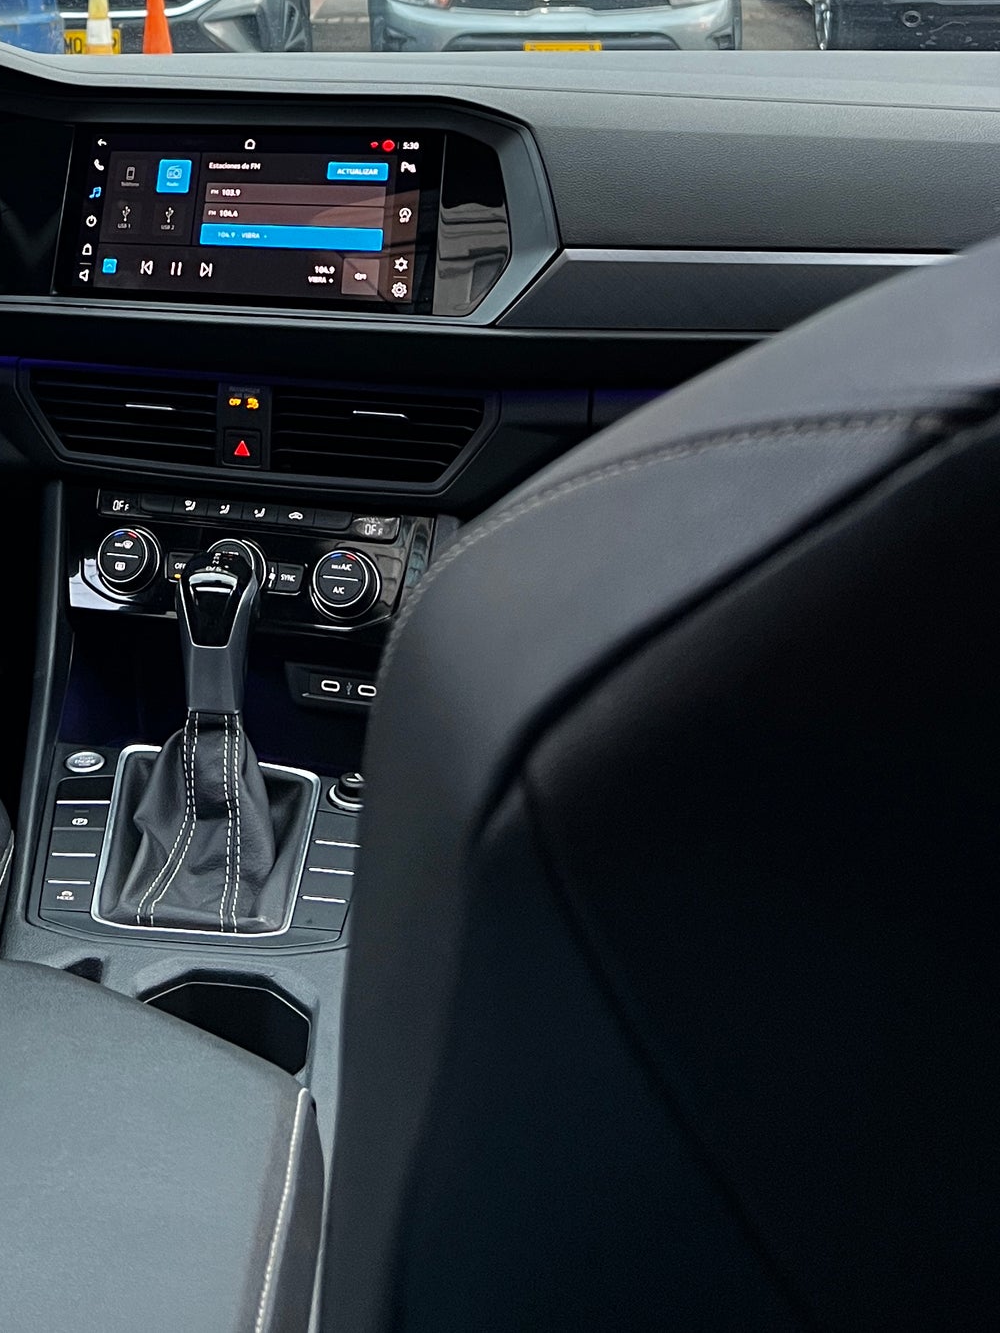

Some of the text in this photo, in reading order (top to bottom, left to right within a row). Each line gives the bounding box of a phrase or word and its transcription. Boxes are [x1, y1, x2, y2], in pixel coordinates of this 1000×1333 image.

[402, 141, 419, 150] 5:30
[280, 573, 295, 582] SYNC
[332, 586, 345, 595] A/C
